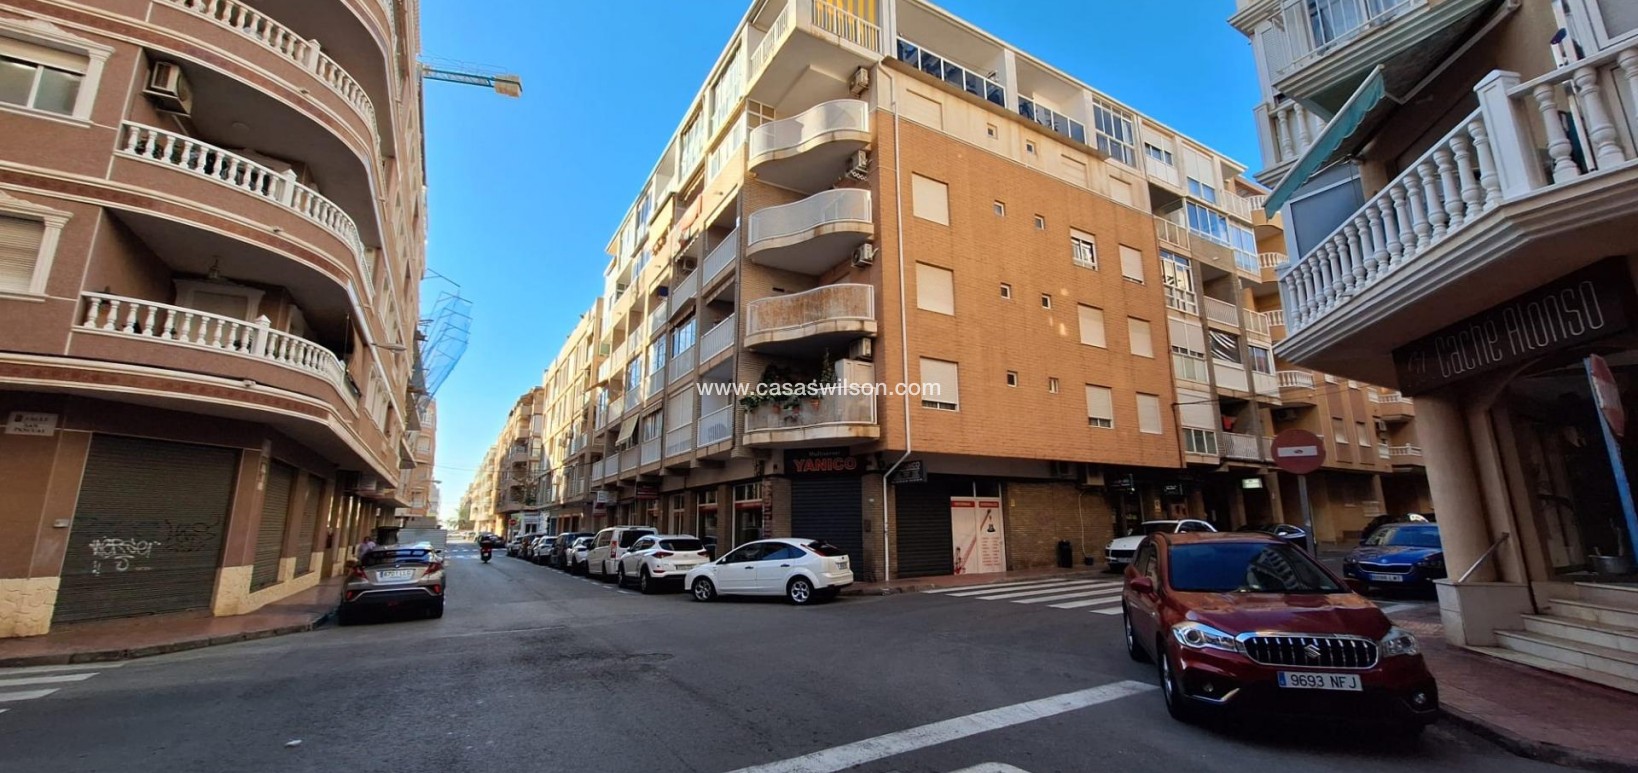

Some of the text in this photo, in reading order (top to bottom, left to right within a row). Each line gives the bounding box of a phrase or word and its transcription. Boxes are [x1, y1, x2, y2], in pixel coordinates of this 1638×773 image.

[1502, 280, 1605, 357] Alonso
[793, 457, 857, 472] YANICO
[1290, 674, 1357, 689] 9693 NFJ
